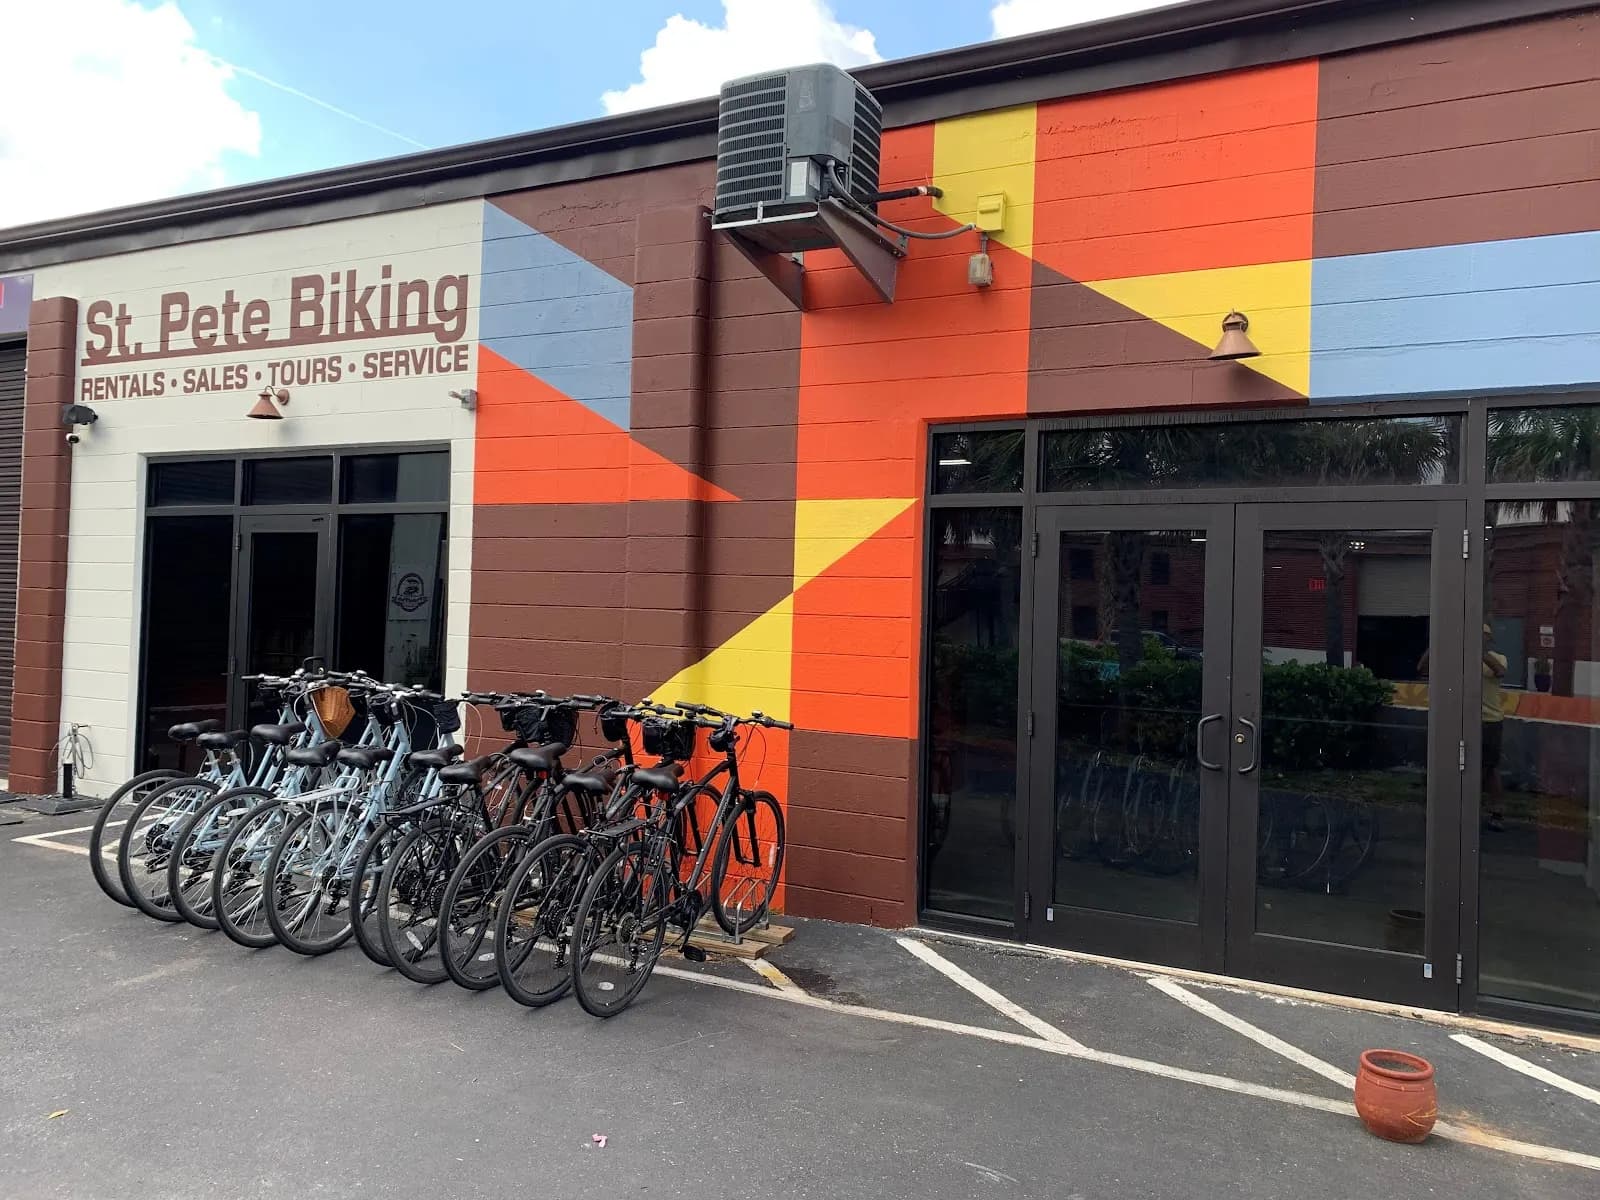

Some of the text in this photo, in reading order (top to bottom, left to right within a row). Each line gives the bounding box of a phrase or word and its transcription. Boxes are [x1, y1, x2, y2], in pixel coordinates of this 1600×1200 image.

[85, 264, 469, 359] St. Pete Biking
[81, 344, 469, 401] RENTALS SALES TOURS SERVICE
